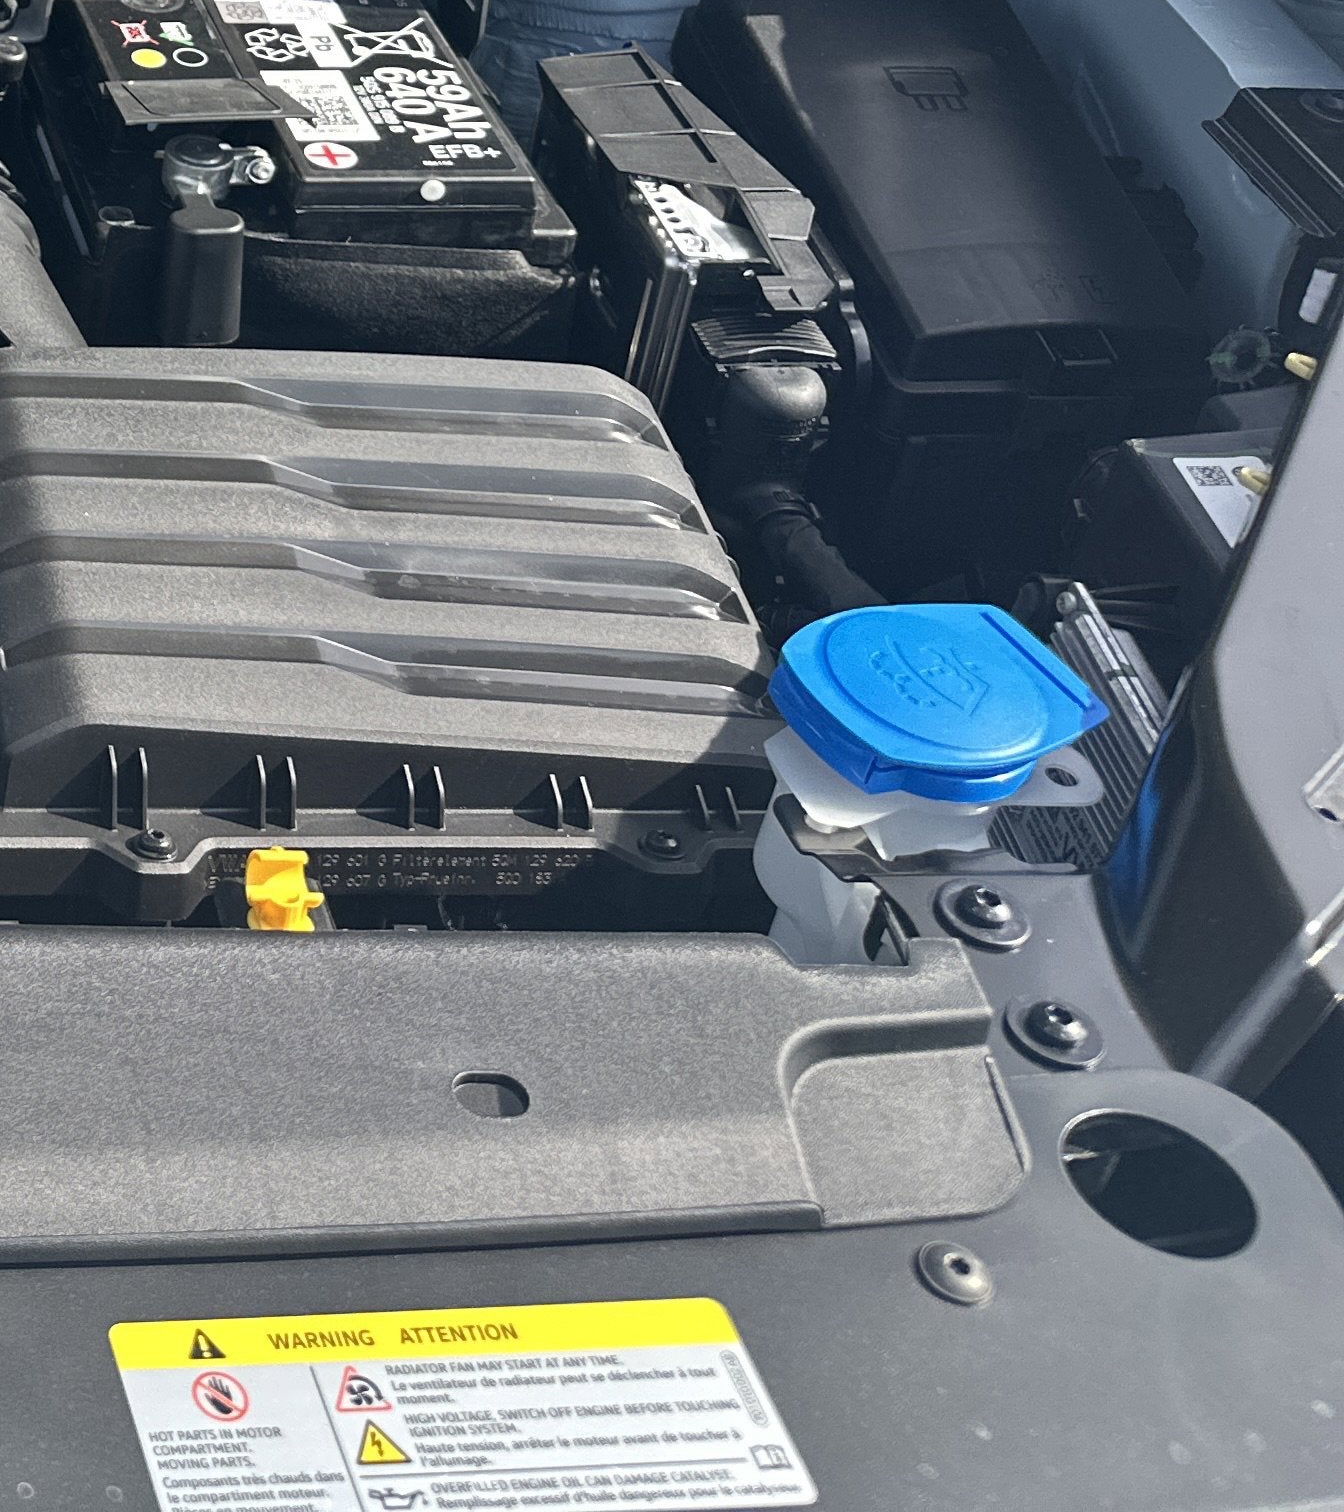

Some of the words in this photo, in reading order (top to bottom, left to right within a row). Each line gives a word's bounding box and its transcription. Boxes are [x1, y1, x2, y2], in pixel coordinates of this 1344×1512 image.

[373, 66, 437, 115] 640
[416, 69, 492, 139] 59Ah
[403, 120, 453, 144] A
[428, 143, 502, 159] EFB+
[267, 1329, 375, 1350] WARNING
[400, 1323, 519, 1344] ATTENTION
[385, 1362, 448, 1375] RADIATOR
[450, 1361, 476, 1373] FAN
[478, 1360, 503, 1372] MAY
[505, 1358, 544, 1370] START
[545, 1357, 560, 1368] AT
[563, 1356, 587, 1367] ANY
[390, 1380, 407, 1391] Le
[409, 1378, 477, 1390] ventilateur
[481, 1376, 496, 1387] de
[498, 1374, 556, 1387] radiateur
[560, 1372, 588, 1386] peut
[590, 1372, 605, 1382] se
[607, 1368, 675, 1380] déclencher
[678, 1366, 687, 1378] à
[689, 1367, 717, 1377] tout
[396, 1394, 456, 1405] moment.
[404, 1413, 436, 1424] HIGH
[498, 1409, 546, 1420] SWITCH
[549, 1407, 572, 1418] OFF
[574, 1404, 621, 1417] ENGINE
[624, 1402, 673, 1414] BEFORE
[675, 1399, 740, 1412] TOUCHING
[148, 1431, 174, 1443] HOT
[177, 1429, 217, 1441] PARTS
[219, 1429, 234, 1440] IN
[236, 1426, 282, 1439] MOTOR
[409, 1425, 467, 1437] IGNITION
[469, 1423, 521, 1435] SYSTEM.
[153, 1442, 253, 1456] COMPARTMENT.
[415, 1442, 455, 1454] Haute
[457, 1440, 510, 1453] tension,
[512, 1437, 556, 1450] arrêter
[557, 1436, 570, 1447] le
[573, 1435, 620, 1448] moteur
[624, 1434, 660, 1444] avant
[662, 1431, 678, 1442] de
[680, 1430, 729, 1441] toucher
[157, 1458, 209, 1470] MOVING
[212, 1456, 256, 1469] PARTS.
[162, 1474, 241, 1489] Composants
[242, 1472, 267, 1486] très
[268, 1471, 312, 1484] chauds
[314, 1470, 344, 1482] dans
[431, 1481, 510, 1494] OVERFILLED
[512, 1479, 558, 1490] ENGINE
[562, 1478, 584, 1488] OIL
[585, 1474, 612, 1487] CAN
[616, 1472, 669, 1485] DAMAGE
[167, 1491, 180, 1504] le
[182, 1489, 275, 1504] compartiment
[278, 1487, 330, 1500] moteur.
[436, 1496, 518, 1509] Remplissage
[520, 1494, 571, 1505] excessif
[619, 1489, 686, 1501] dangereux
[690, 1488, 718, 1498] pour
